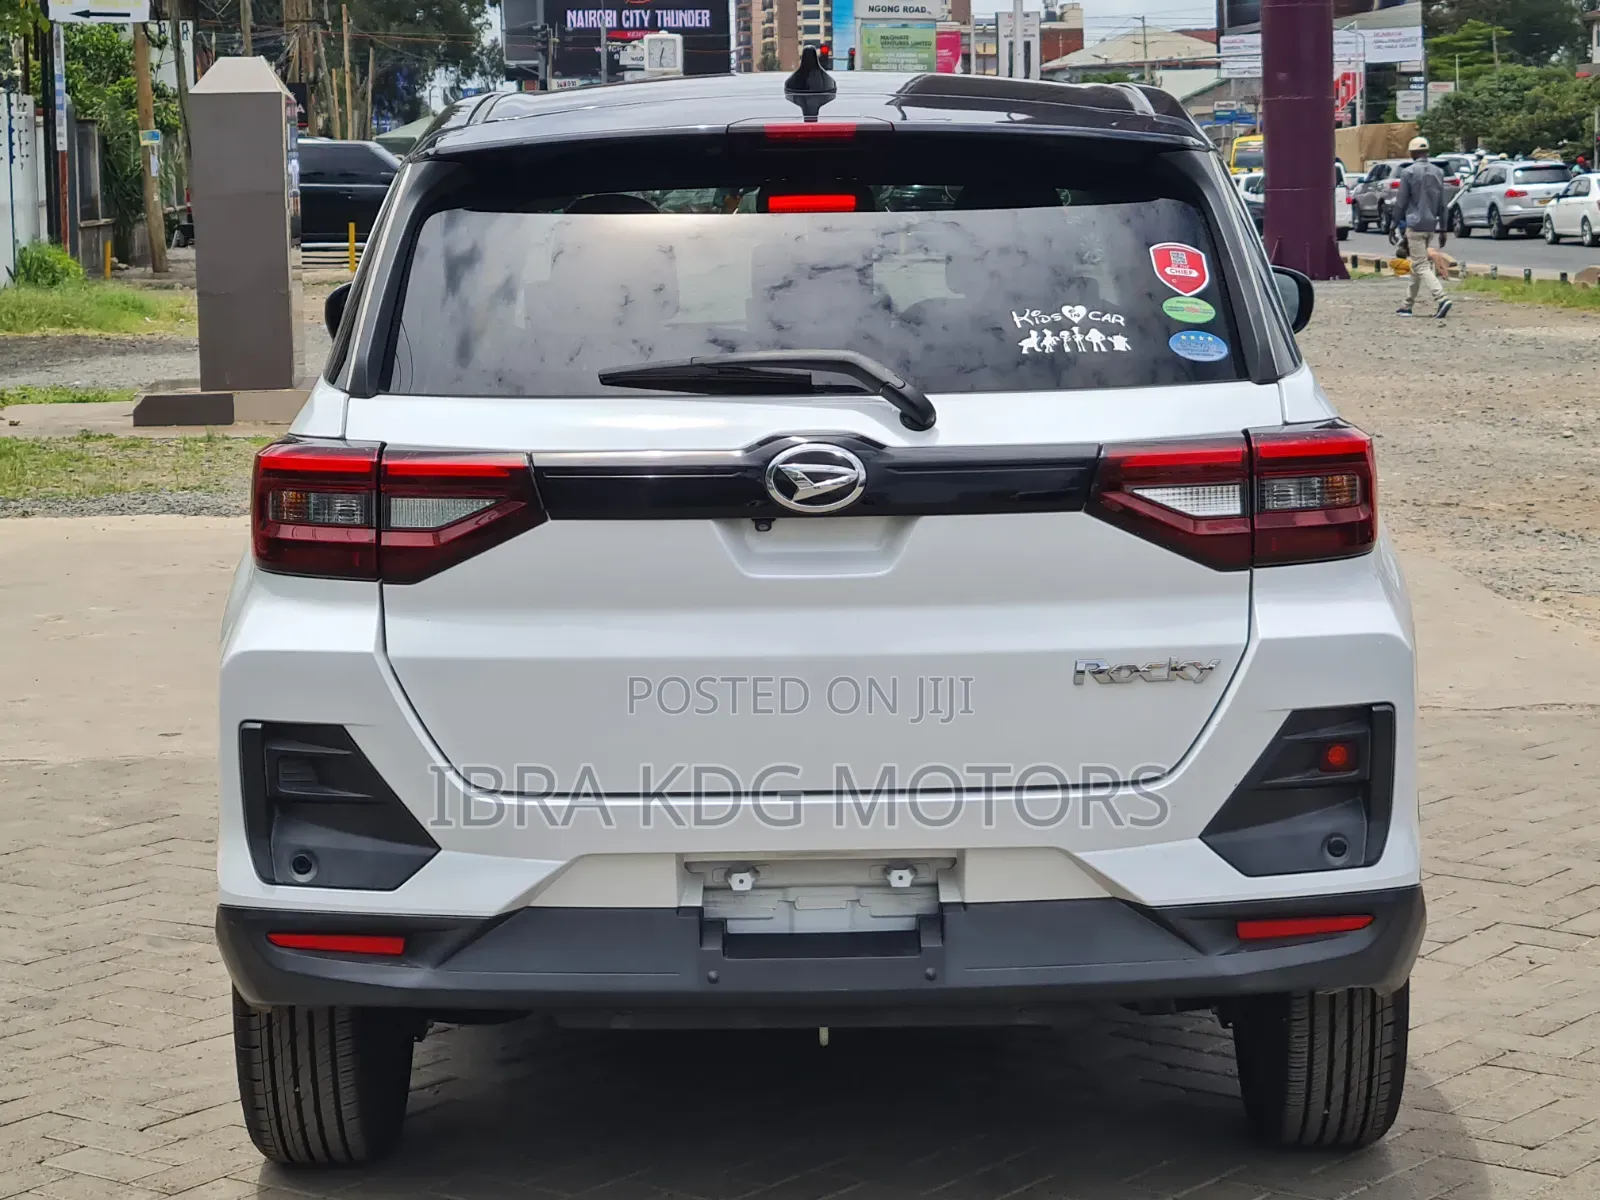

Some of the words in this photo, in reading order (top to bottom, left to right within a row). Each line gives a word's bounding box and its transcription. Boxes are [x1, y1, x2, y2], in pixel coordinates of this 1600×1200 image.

[868, 5, 900, 13] NGONG
[621, 10, 650, 28] CITY
[655, 10, 711, 27] THUNDER
[1169, 268, 1194, 276] CHIEF
[1088, 311, 1126, 326] CAR
[1073, 655, 1221, 686] Rocky
